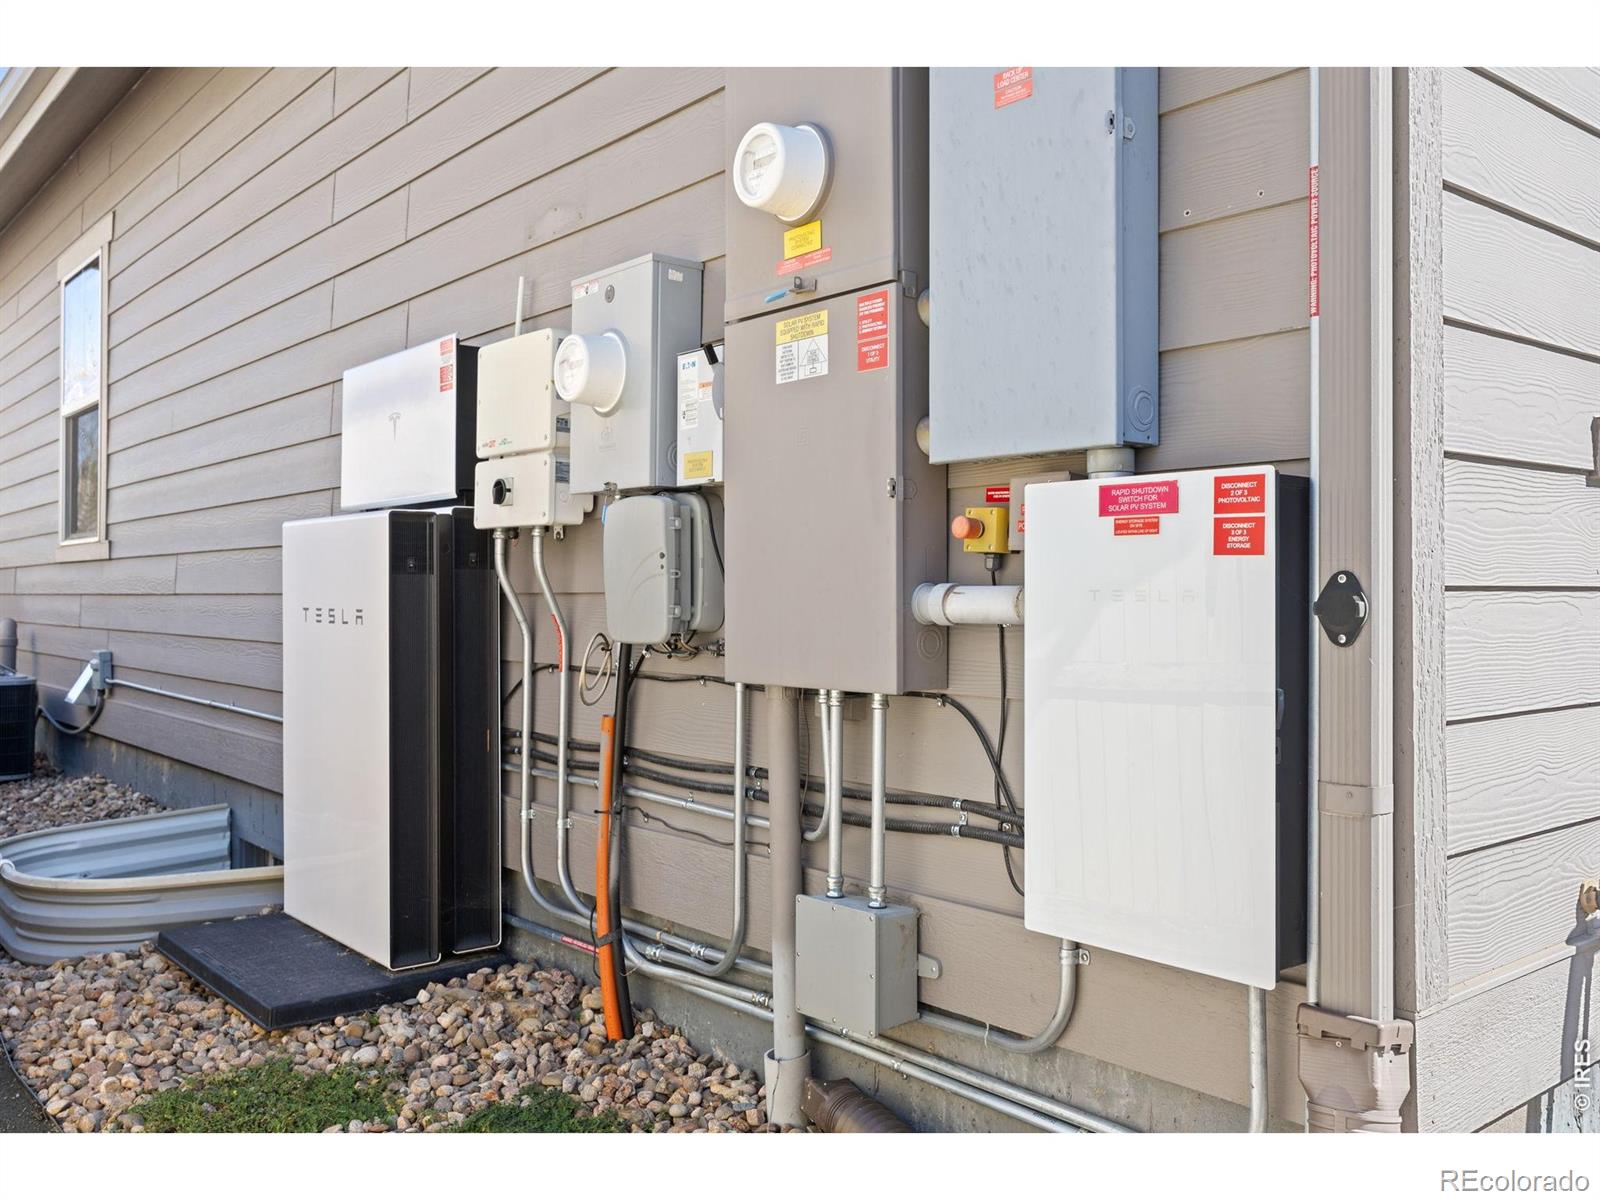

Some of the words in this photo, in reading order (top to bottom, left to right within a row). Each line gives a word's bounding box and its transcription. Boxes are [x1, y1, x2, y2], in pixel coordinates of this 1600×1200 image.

[1311, 168, 1319, 197] SOURCE
[784, 319, 798, 328] SOLAR
[804, 313, 821, 323] SYSTEM
[861, 343, 885, 352] DISCONNECT
[866, 356, 880, 364] UTILITY
[1221, 481, 1257, 489] DISCONNECT
[1112, 488, 1130, 496] RAPID
[1131, 486, 1168, 495] SHUTDOWN
[1118, 495, 1143, 503] SWITCH
[1144, 494, 1158, 502] FOR
[1217, 496, 1260, 504] PHOTOVOLTAIC
[1108, 504, 1129, 512] SOLAR
[1140, 502, 1167, 510] SYSTEM
[1088, 589, 1196, 602] TESLA
[303, 607, 363, 625] TESLA
